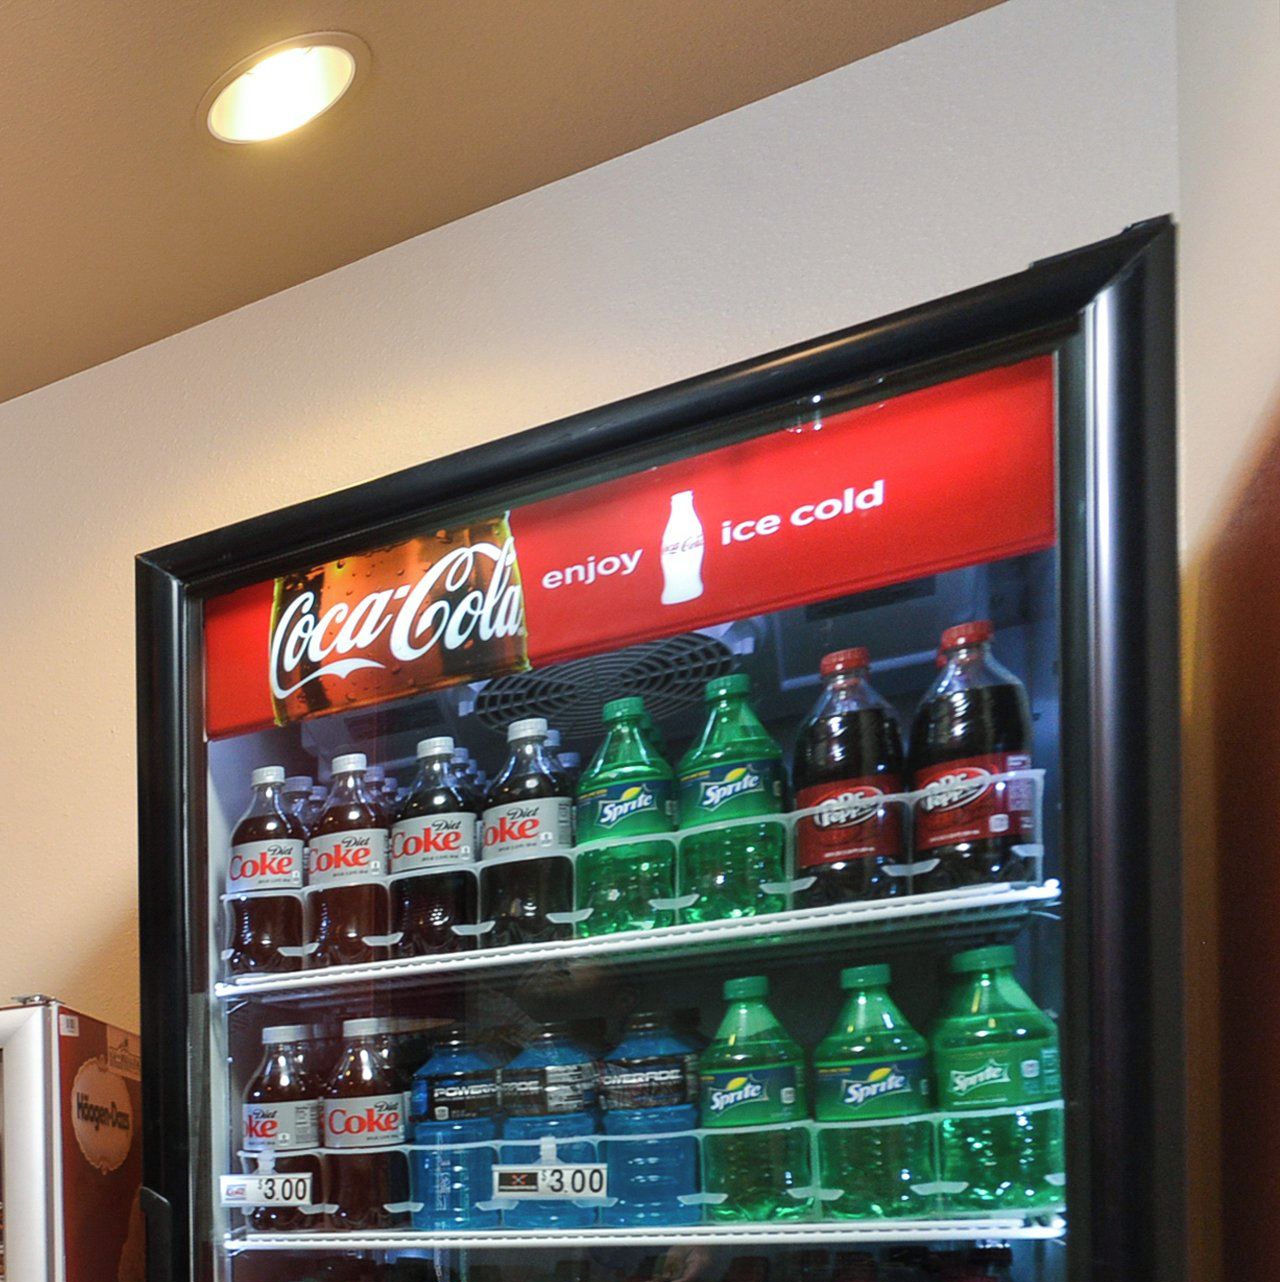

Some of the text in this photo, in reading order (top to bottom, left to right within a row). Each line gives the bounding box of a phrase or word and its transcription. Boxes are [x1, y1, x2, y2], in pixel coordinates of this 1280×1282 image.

[720, 480, 886, 547] ice cold
[541, 545, 643, 592] enjoy
[271, 537, 527, 702] Coca-Cola
[704, 771, 760, 806] Sprite
[507, 806, 540, 820] Diet
[602, 791, 654, 824] Sprite
[433, 819, 461, 831] Diet
[267, 845, 293, 857] Diet
[342, 835, 371, 848] Diet
[392, 828, 463, 859] Coke
[230, 850, 294, 879] Coke
[308, 844, 372, 874] Coke
[844, 1072, 907, 1106] Sprite
[952, 1064, 1006, 1093] Sprite
[710, 1083, 762, 1110] Sprite
[76, 1091, 130, 1132] Häagen-Dazs
[328, 1108, 400, 1135] Coke
[258, 1178, 307, 1201] $3.00
[541, 1168, 604, 1195] $3.00
